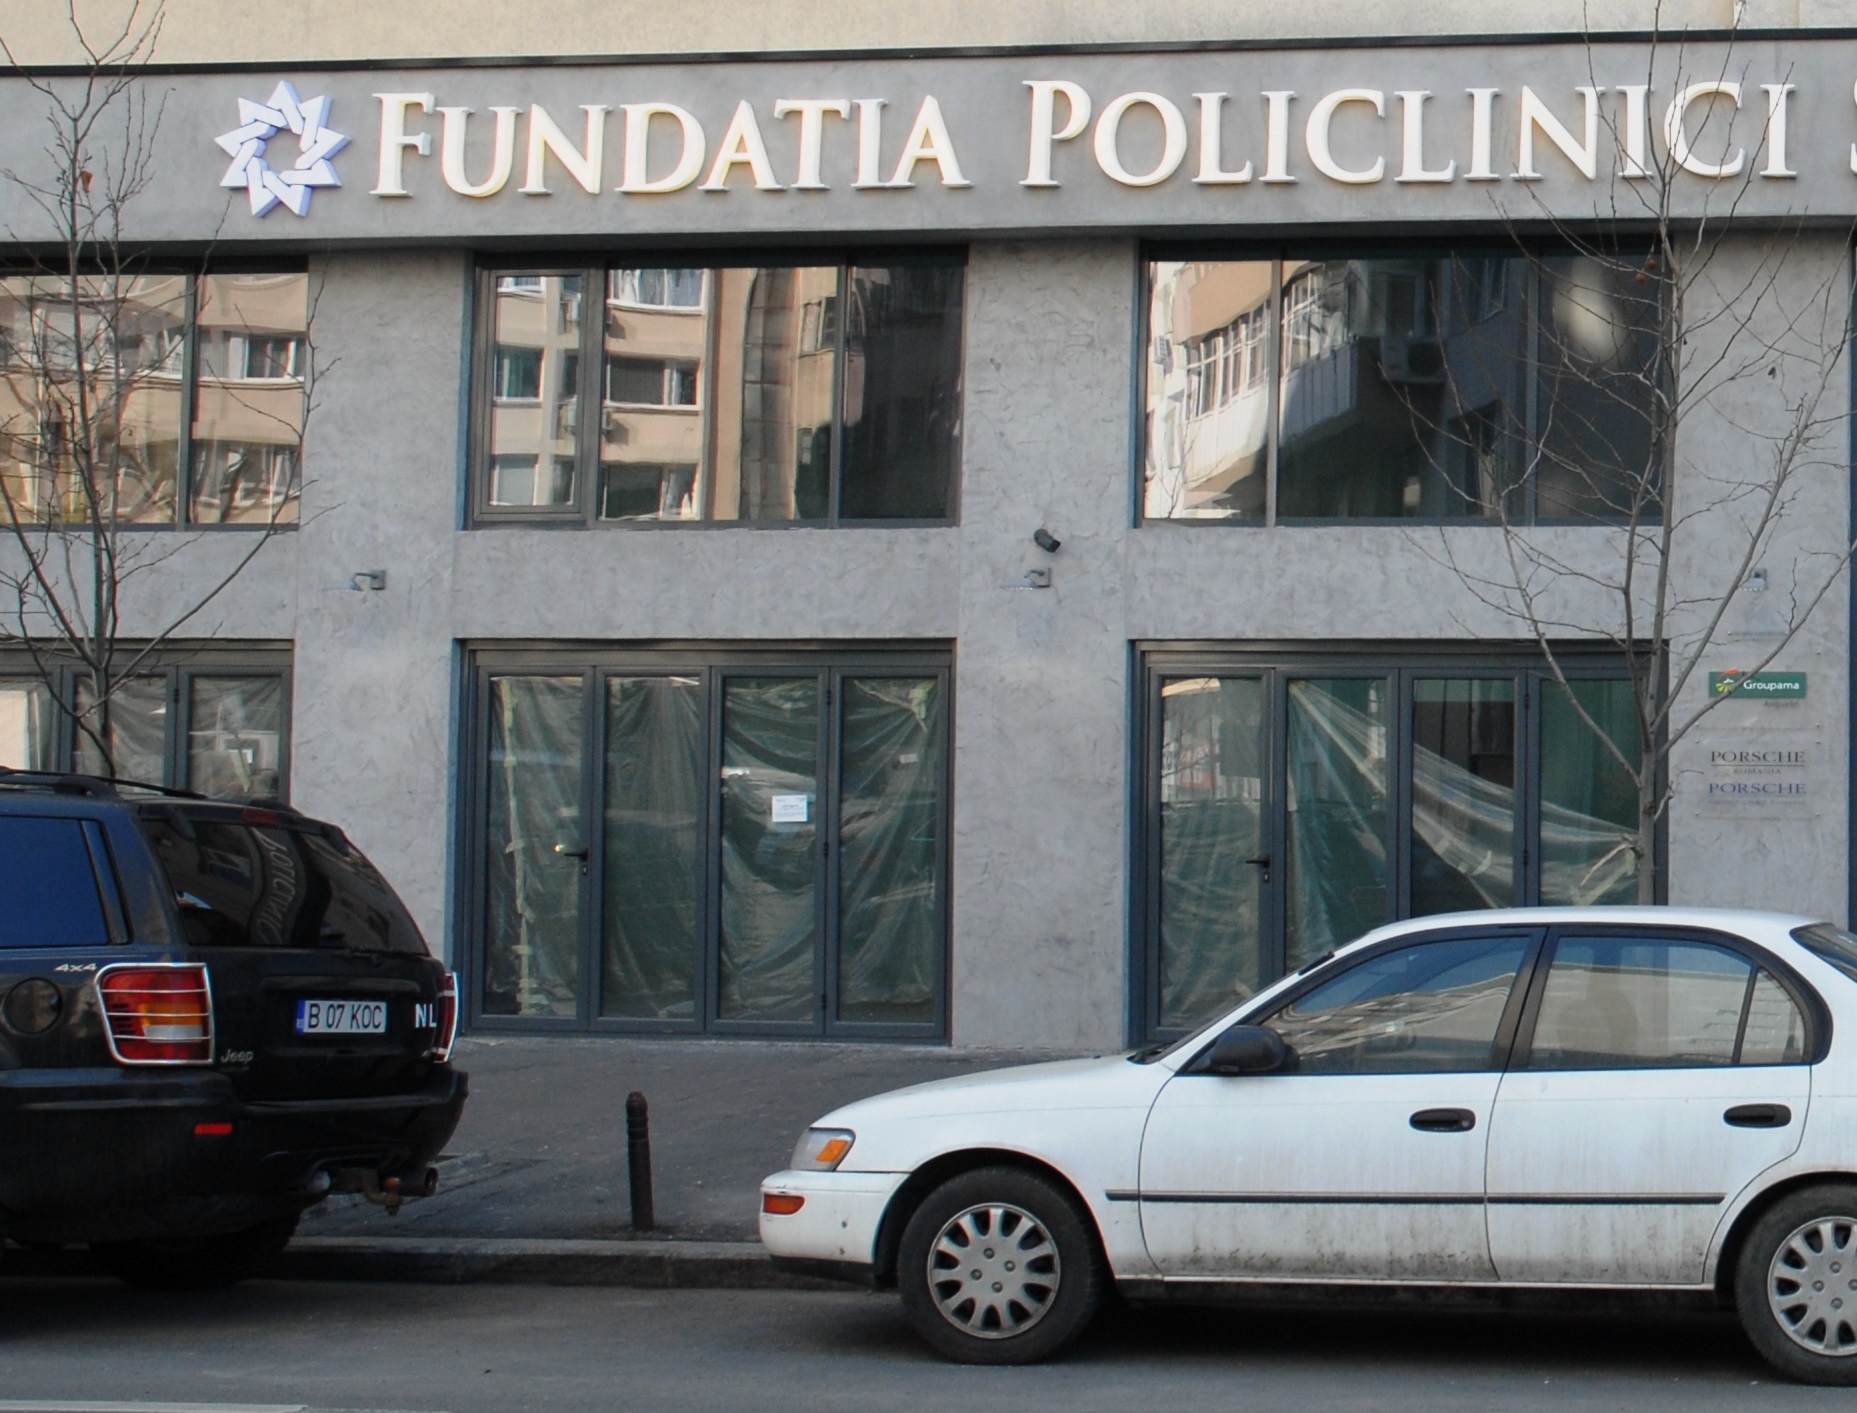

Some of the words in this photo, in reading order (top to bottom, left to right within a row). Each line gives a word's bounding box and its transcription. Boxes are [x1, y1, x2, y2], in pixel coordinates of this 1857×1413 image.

[370, 92, 975, 198] FUNDATIA
[1018, 80, 1800, 188] POLICLINICI
[1743, 679, 1800, 692] Groupama
[1711, 751, 1805, 763] PORSCHE
[1709, 782, 1807, 794] PORSCHE
[54, 962, 98, 973] 4x4
[308, 1003, 322, 1030] B
[326, 1003, 345, 1030] 07
[350, 1004, 383, 1030] KOC
[415, 1003, 437, 1029] NL
[220, 1048, 254, 1065] Jeep
